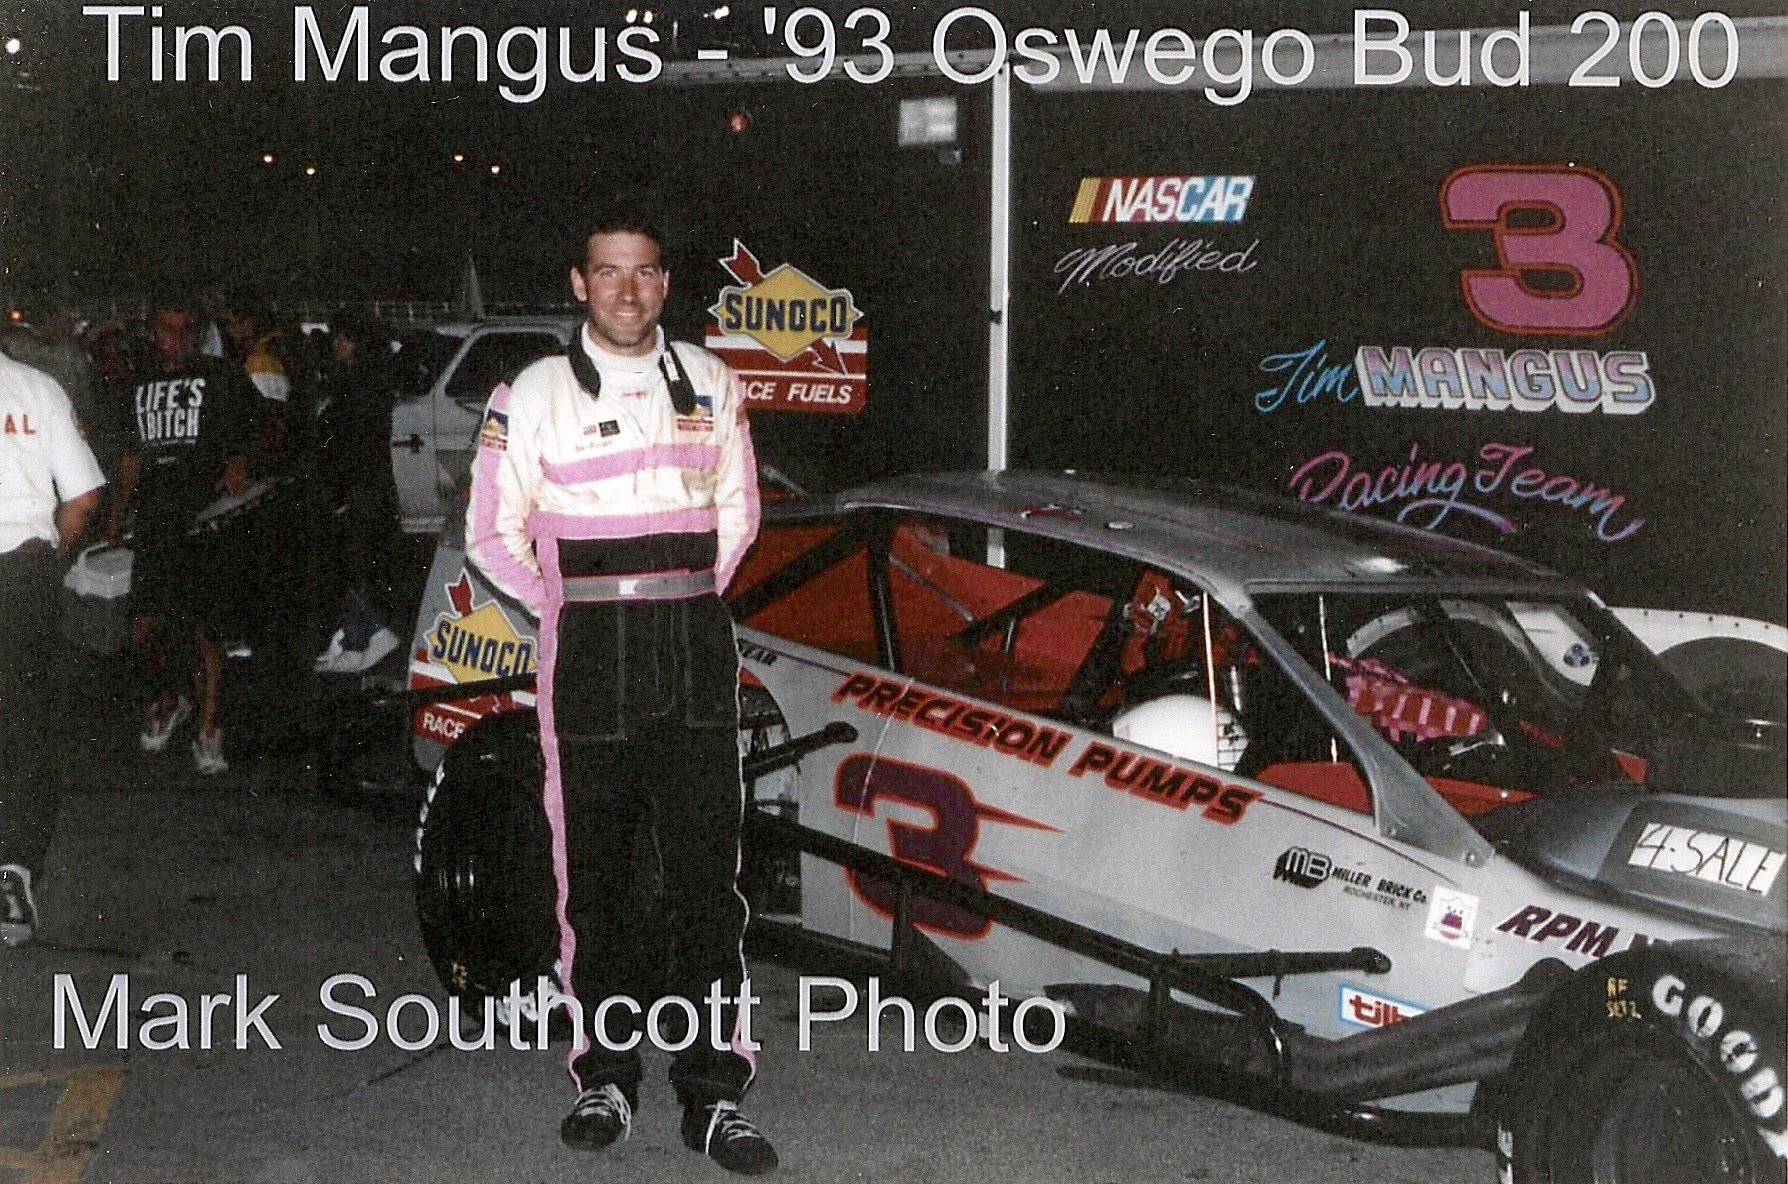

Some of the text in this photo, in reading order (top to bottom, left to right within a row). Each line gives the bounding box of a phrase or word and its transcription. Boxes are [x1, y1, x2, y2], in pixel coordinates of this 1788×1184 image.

[1102, 176, 1252, 223] NASCAR
[1054, 238, 1261, 295] Modified
[1441, 163, 1640, 336] 3
[724, 292, 847, 333] SUNOCO
[135, 377, 207, 415] LIFE'S
[743, 381, 853, 405] CE FUELS
[1255, 338, 1656, 416] Tim MANGUS
[1473, 441, 1645, 543] Team
[432, 619, 532, 679] SUNOCO
[831, 670, 1265, 826] PRECISION PUMPS
[834, 752, 993, 941] 3
[1332, 866, 1372, 888] MILLER
[1376, 877, 1414, 901] BRICK
[1495, 903, 1621, 957] RPM
